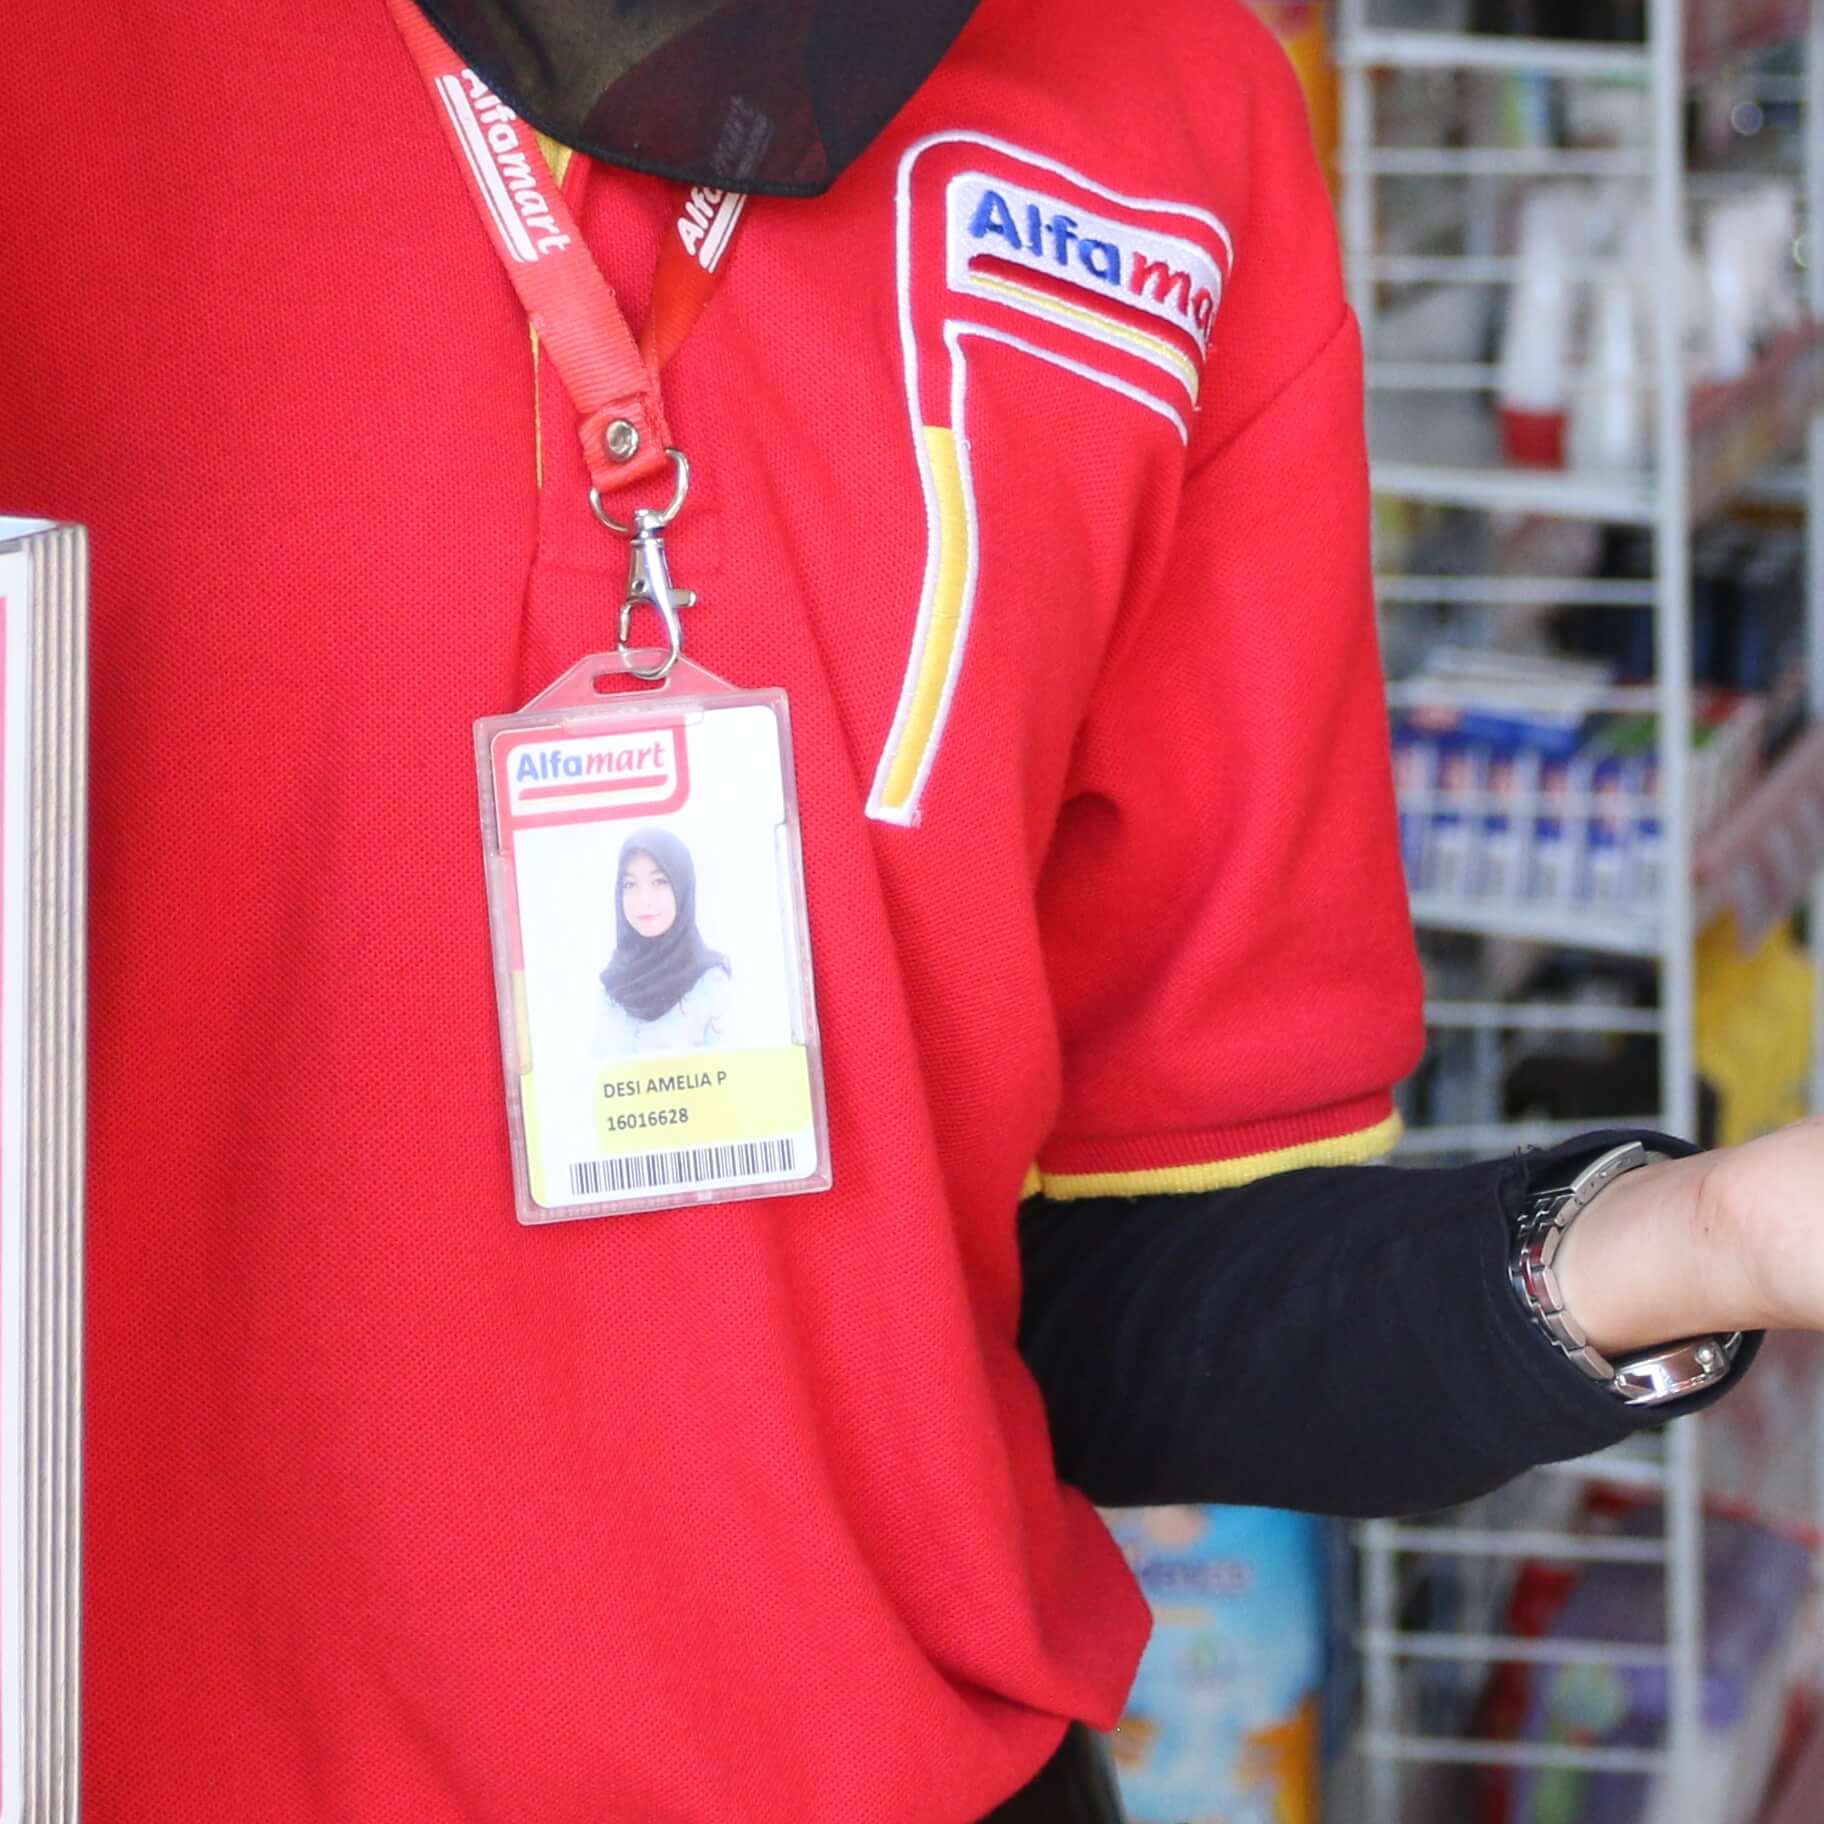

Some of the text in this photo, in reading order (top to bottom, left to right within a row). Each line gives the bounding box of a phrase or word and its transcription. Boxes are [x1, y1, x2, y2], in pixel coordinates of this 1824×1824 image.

[968, 189, 1215, 332] Alfama
[515, 741, 665, 783] Alfamart
[603, 1071, 727, 1098] DESI AMELIA P
[607, 1107, 689, 1131] 16016628
